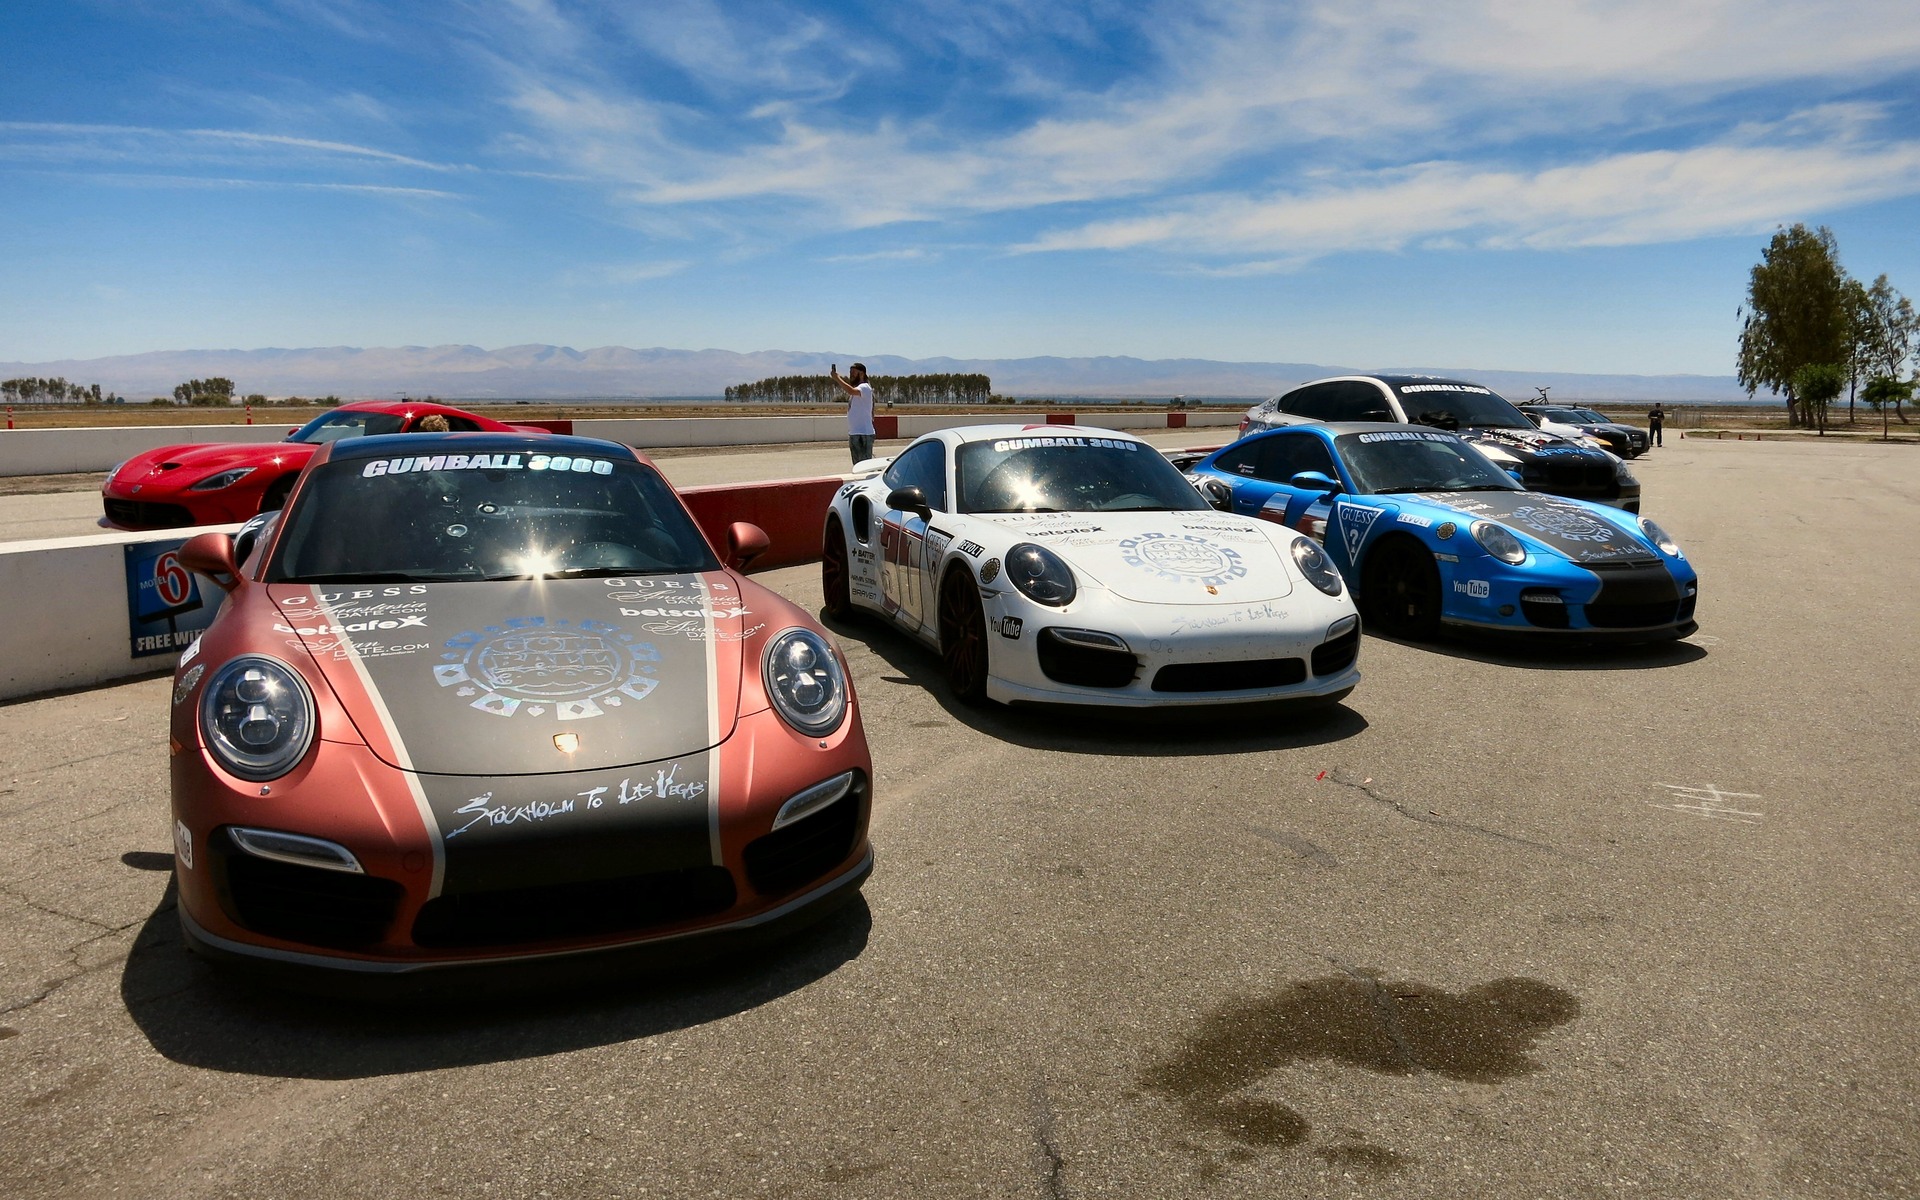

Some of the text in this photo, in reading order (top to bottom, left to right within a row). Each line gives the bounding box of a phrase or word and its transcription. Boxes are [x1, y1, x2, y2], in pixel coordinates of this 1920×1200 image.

[1400, 384, 1463, 394] GUMBALL
[994, 437, 1138, 453] GUMBALL 3000
[1358, 432, 1459, 445] GUMBALL 3000
[362, 453, 614, 479] GUMBALL 3000
[1341, 508, 1374, 525] GUESS
[1398, 512, 1431, 527] REVOLT
[140, 551, 192, 607] MOTEL 6
[603, 578, 729, 591] GUESS
[281, 584, 428, 605] GUESS
[1453, 580, 1489, 597] YouTube
[990, 616, 1022, 638] YouTube
[137, 634, 171, 652] FREE
[174, 628, 206, 646] WiF
[334, 643, 430, 658] DATE.COM
